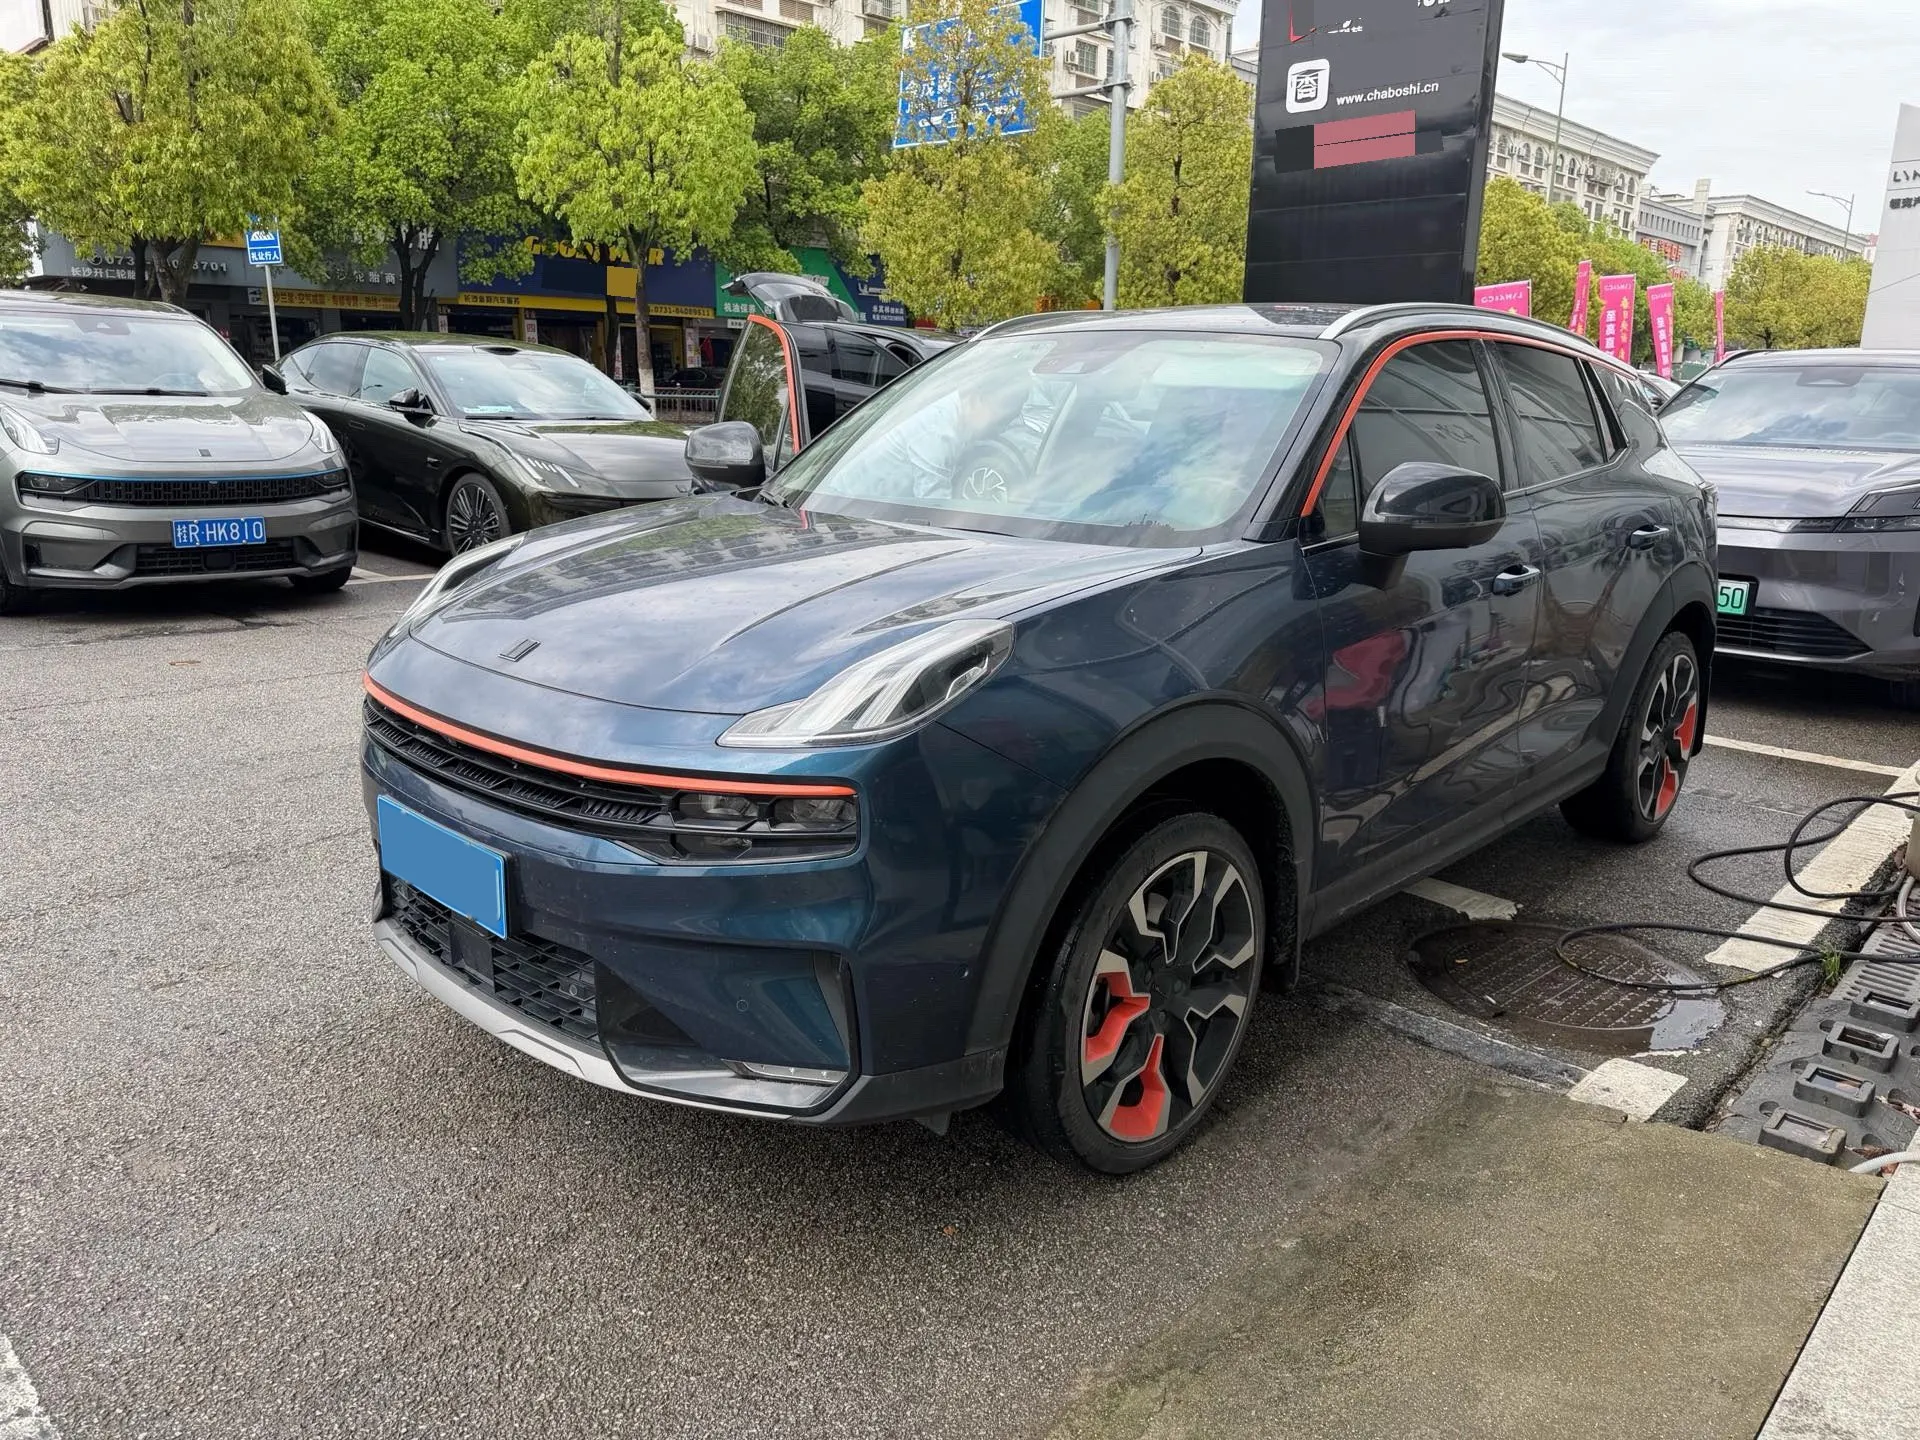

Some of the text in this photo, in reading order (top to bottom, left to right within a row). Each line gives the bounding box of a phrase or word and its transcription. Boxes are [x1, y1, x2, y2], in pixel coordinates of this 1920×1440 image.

[1336, 82, 1440, 106] www.chaboshi.cn
[250, 250, 280, 262] 礼让行人
[1717, 585, 1745, 609] 50
